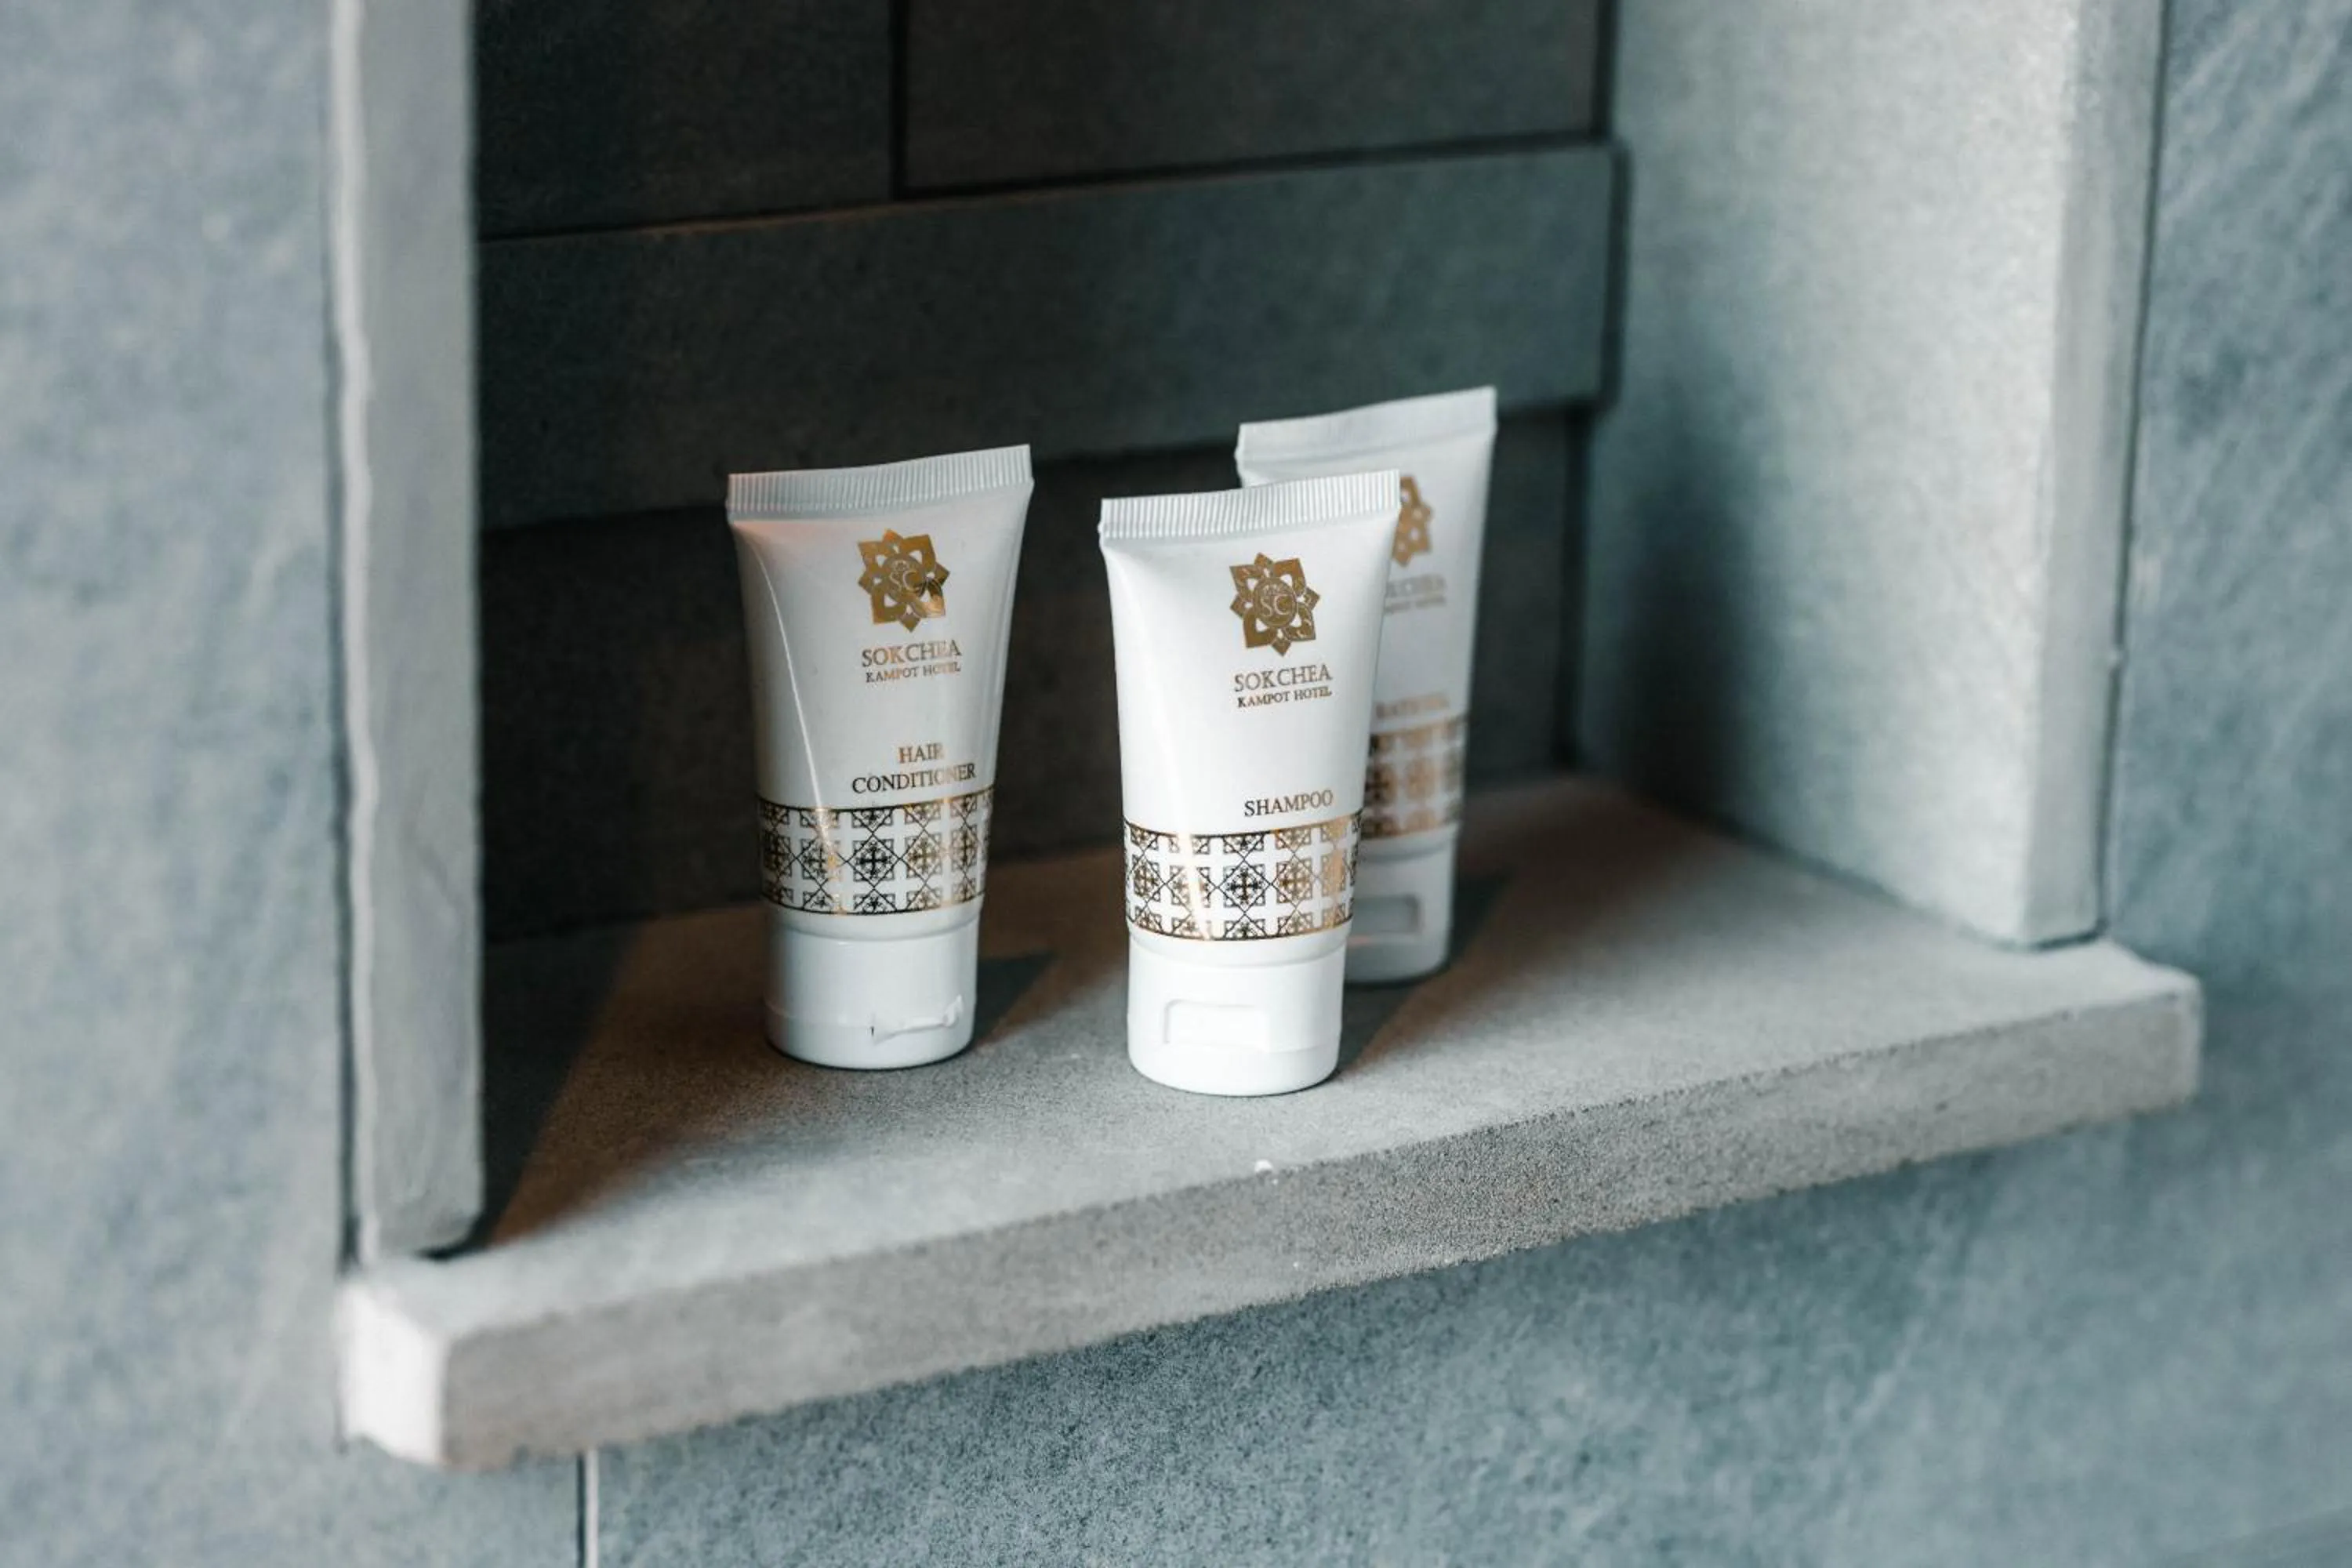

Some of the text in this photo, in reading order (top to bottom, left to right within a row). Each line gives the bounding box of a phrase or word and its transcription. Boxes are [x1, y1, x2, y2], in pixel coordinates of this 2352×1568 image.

[862, 639, 963, 667] SOKCHEA
[865, 666, 918, 683] KAMPOT
[1233, 664, 1333, 692] SOKCHEA
[1236, 686, 1332, 708] KAMPOT HOTEL
[851, 762, 977, 794] CONDITIONER
[1243, 789, 1334, 818] SHAMPOO
